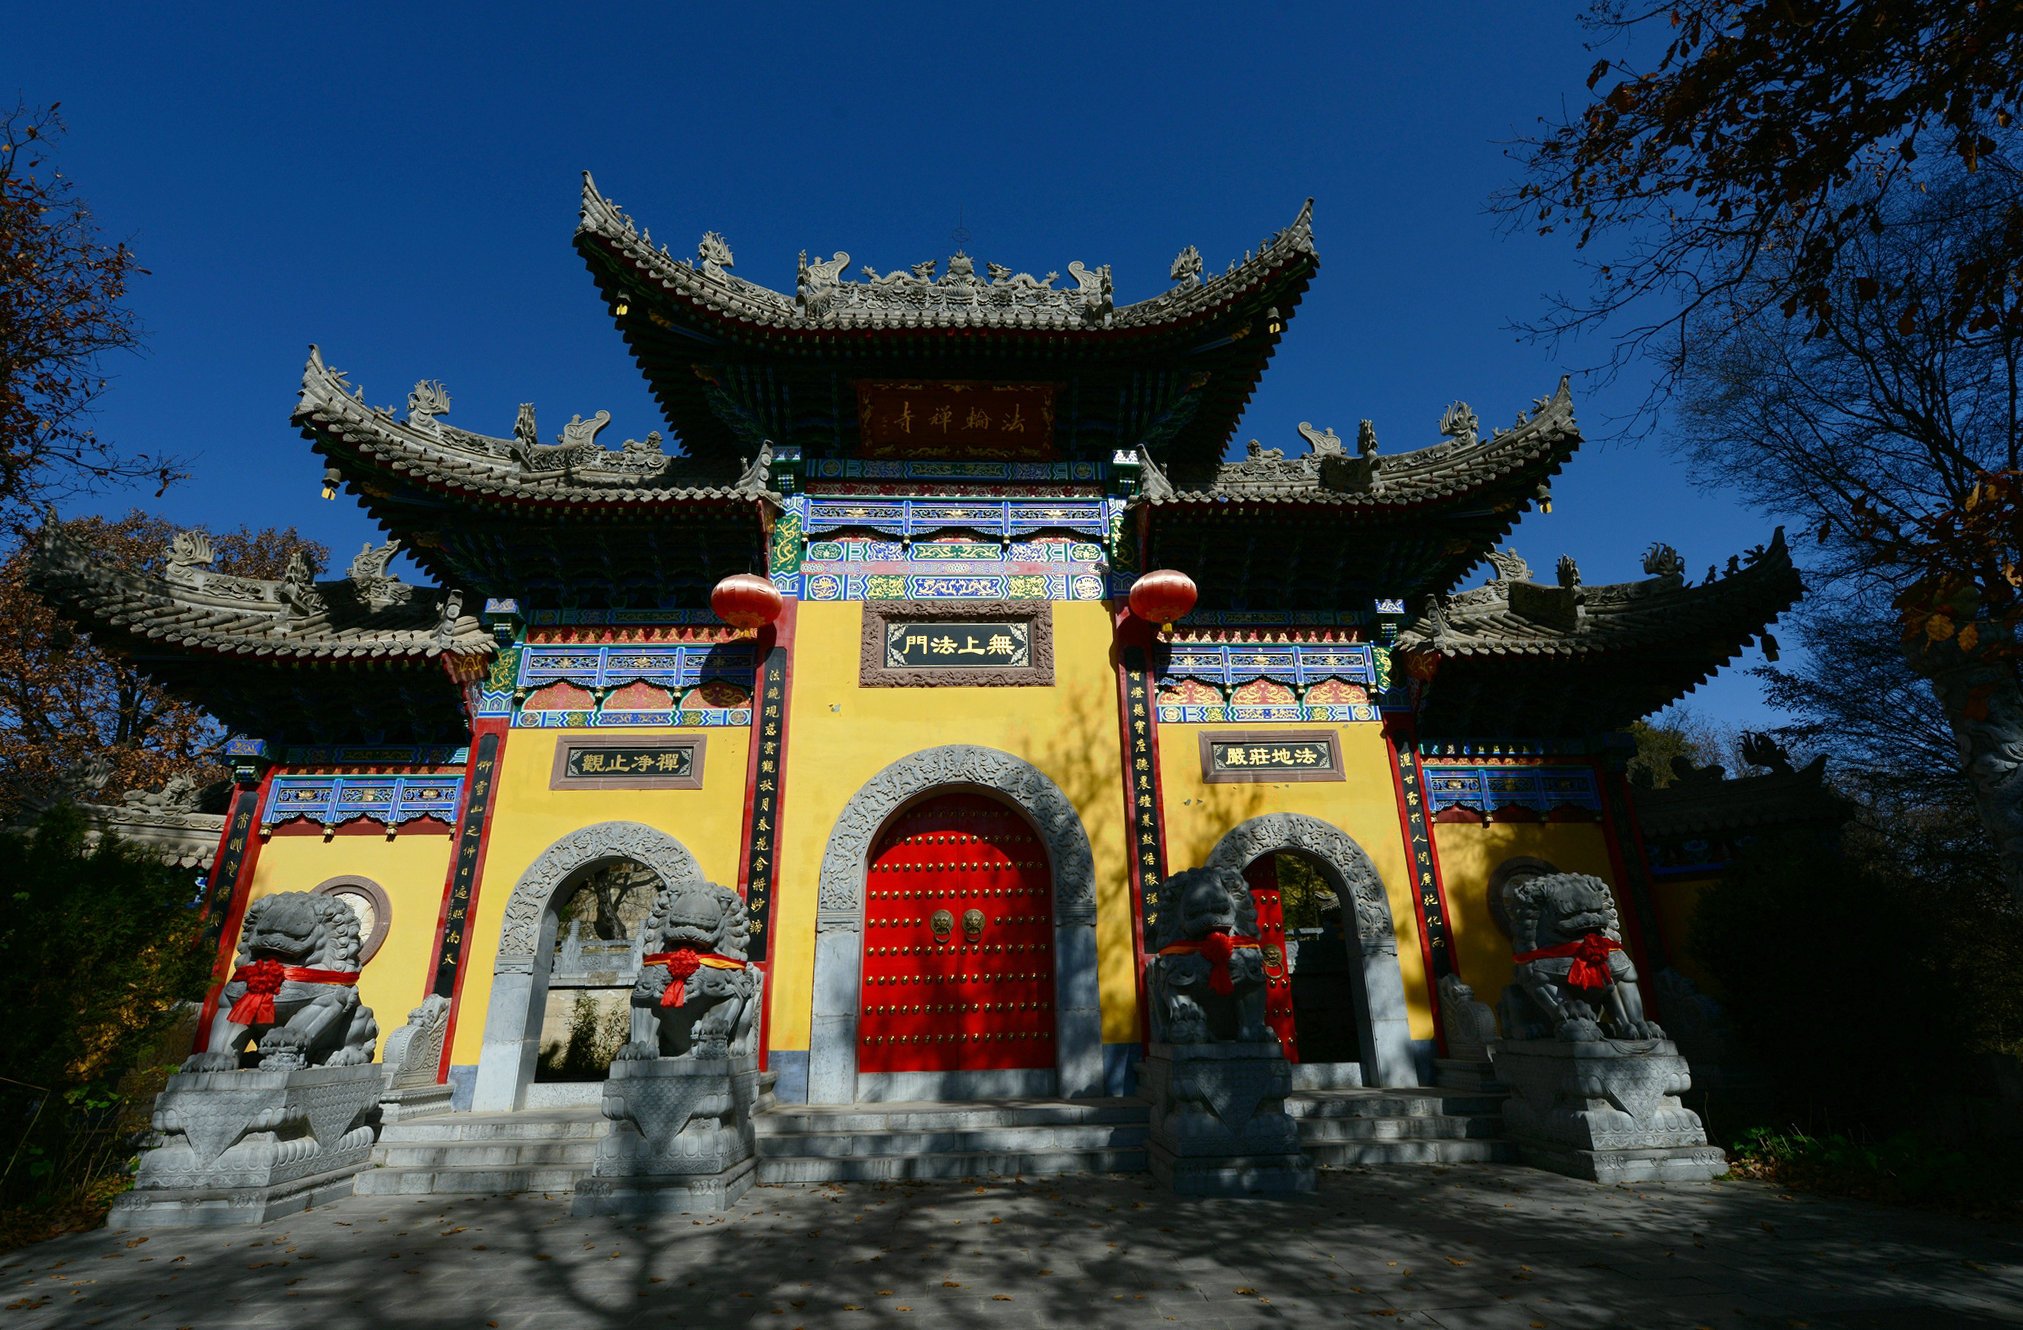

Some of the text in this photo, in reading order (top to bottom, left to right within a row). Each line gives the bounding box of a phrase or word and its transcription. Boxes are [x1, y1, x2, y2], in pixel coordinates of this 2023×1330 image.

[903, 633, 1016, 656] 無上法門
[1225, 746, 1319, 766] 法地莊嚴
